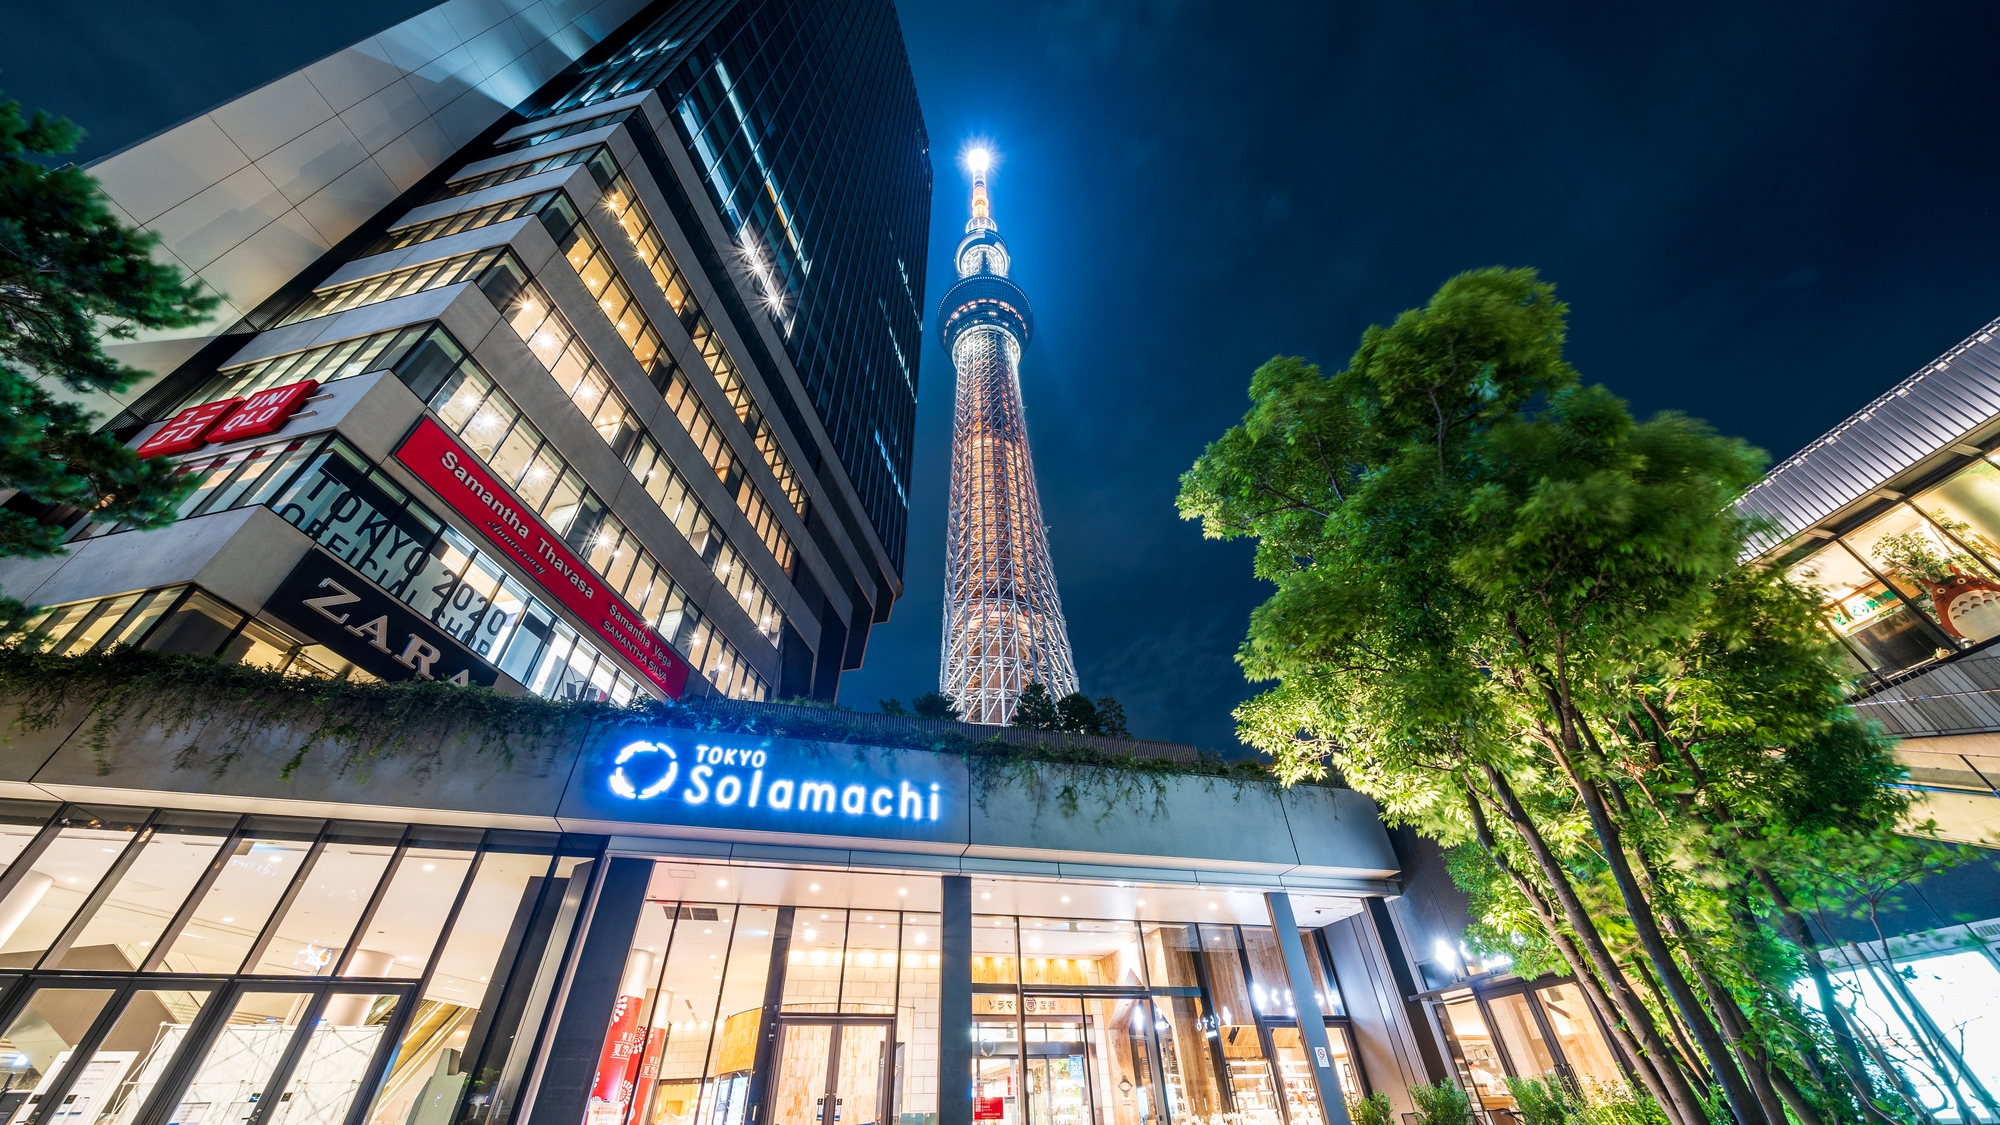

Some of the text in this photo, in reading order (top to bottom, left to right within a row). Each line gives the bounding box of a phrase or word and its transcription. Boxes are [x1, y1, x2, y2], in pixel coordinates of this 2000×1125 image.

[171, 404, 225, 428] ユニ
[222, 406, 279, 433] QLO
[244, 388, 297, 412] UNI
[146, 423, 206, 449] クロ
[306, 466, 508, 636] TOKYO 2020
[441, 451, 595, 600] Samantha Thavasa
[485, 520, 547, 575] Anniversary
[302, 577, 471, 687] ZARA
[602, 620, 667, 683] SAMANTHA SILVA
[609, 604, 672, 668] Samantha Vega
[696, 745, 767, 769] TOKYO
[684, 764, 941, 822] Solamachi
